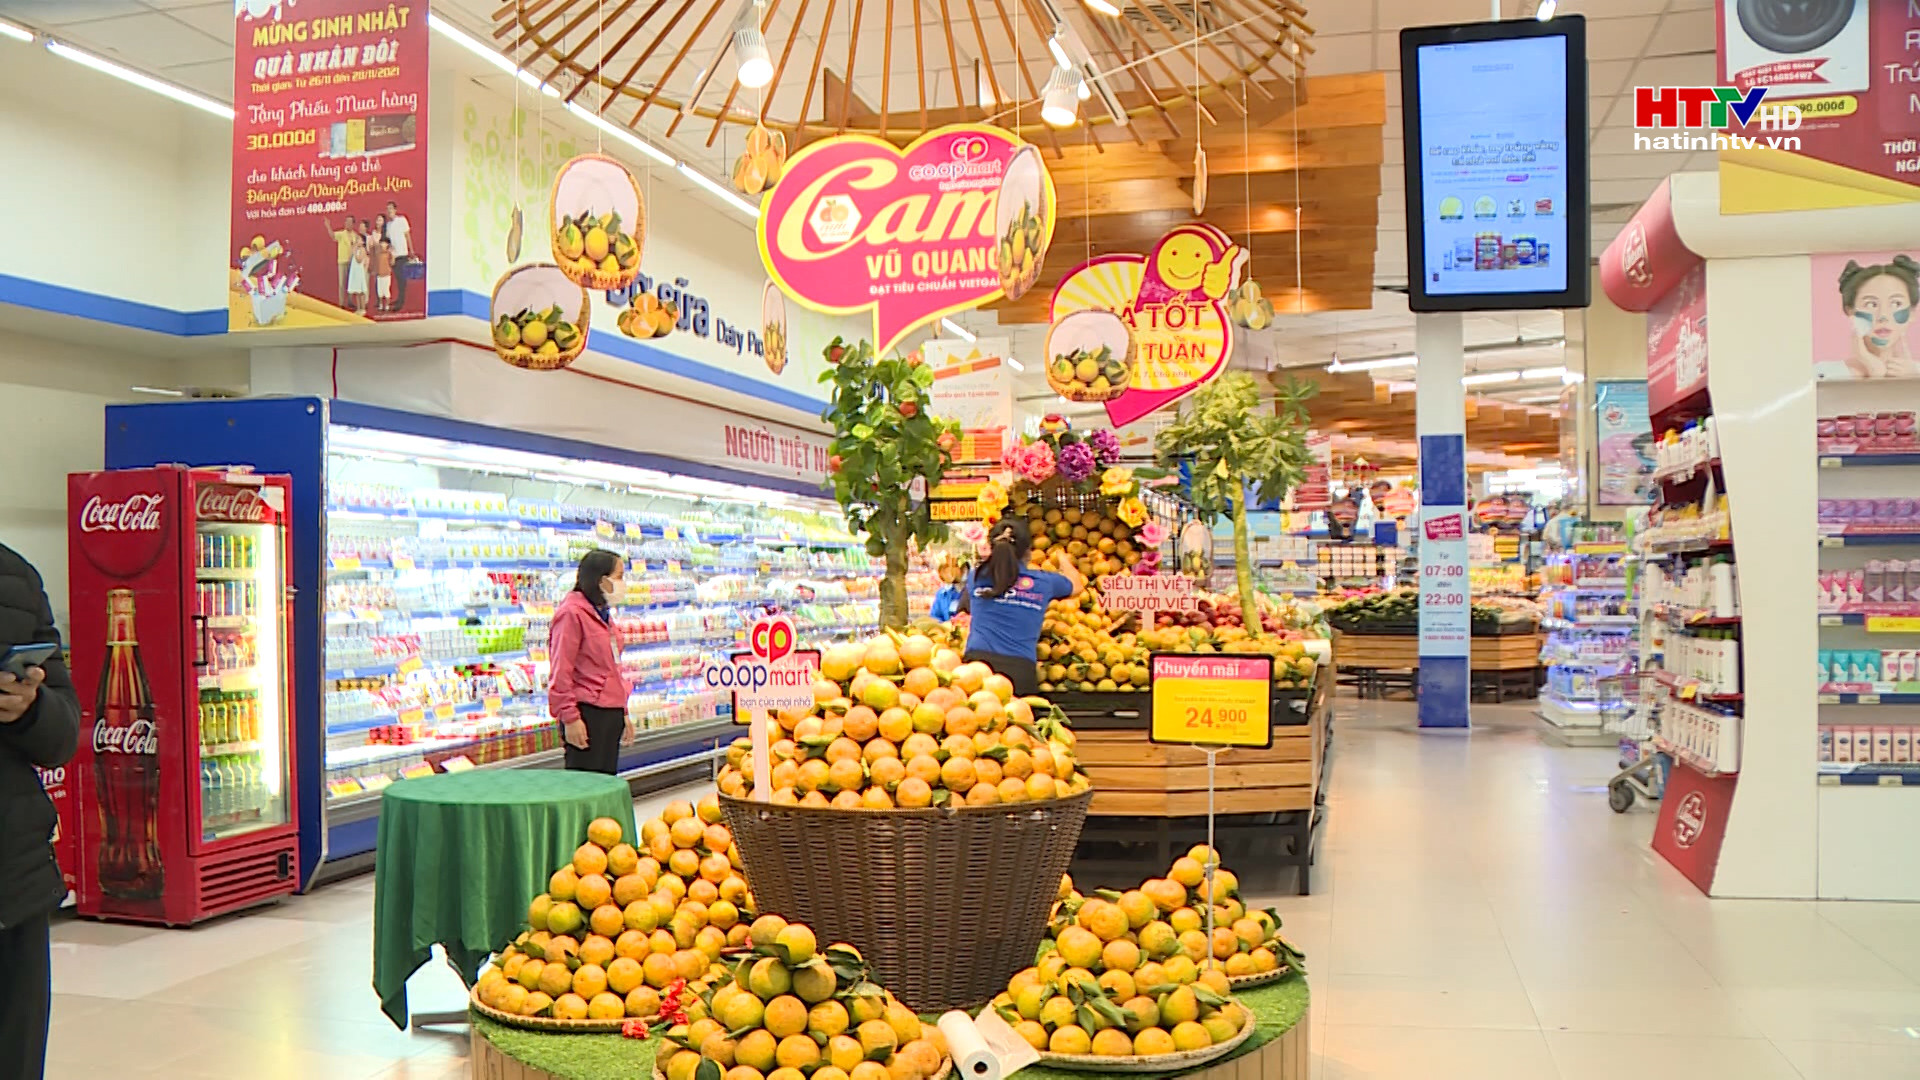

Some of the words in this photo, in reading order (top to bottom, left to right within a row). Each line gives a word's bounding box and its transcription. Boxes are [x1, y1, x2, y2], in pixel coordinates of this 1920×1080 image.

[252, 19, 308, 47] MỪNG
[311, 14, 353, 40] SINH
[357, 3, 410, 34] NHẬT
[253, 50, 294, 79] QUÀ
[297, 43, 358, 73] NHÂN
[361, 37, 400, 66] ĐÔI
[247, 103, 285, 128] Tặng
[290, 98, 331, 121] Phiếu
[336, 94, 378, 114] Mua
[381, 89, 417, 112] hàng
[246, 128, 316, 150] 30.000đ
[1883, 140, 1916, 154] THỜI
[247, 169, 267, 184] cho
[270, 164, 307, 181] khách
[310, 163, 341, 180] hàng
[344, 159, 358, 174] có
[384, 175, 412, 192] Kim
[776, 157, 1000, 262] Cam
[866, 248, 902, 279] VŨ
[869, 283, 891, 296] ĐẠT
[893, 279, 915, 294] TIÊU
[917, 277, 956, 292] CHUẨN
[1145, 292, 1207, 328] TỐT
[1144, 335, 1206, 360] TUẦN
[724, 424, 776, 464] NGƯỜI
[780, 435, 810, 475] VIỆT
[80, 493, 164, 533] Coca-Cola
[196, 485, 264, 521] Coca-Cola
[1102, 576, 1133, 591] SIÊU
[1138, 578, 1158, 594] THỊ
[1161, 572, 1193, 593] VIỆT
[1425, 565, 1463, 577] 07:00
[1097, 594, 1113, 609] VÌ
[1165, 593, 1199, 615] VIỆT
[1425, 593, 1463, 605] 22:00
[1154, 660, 1209, 678] Khuyến
[1212, 662, 1239, 676] mãi
[740, 697, 757, 708] bạn
[758, 696, 775, 706] của
[776, 697, 792, 708] mọi
[793, 696, 811, 707] nhà
[1185, 707, 1248, 729] 24.900
[93, 719, 158, 756] Coca-Cola
